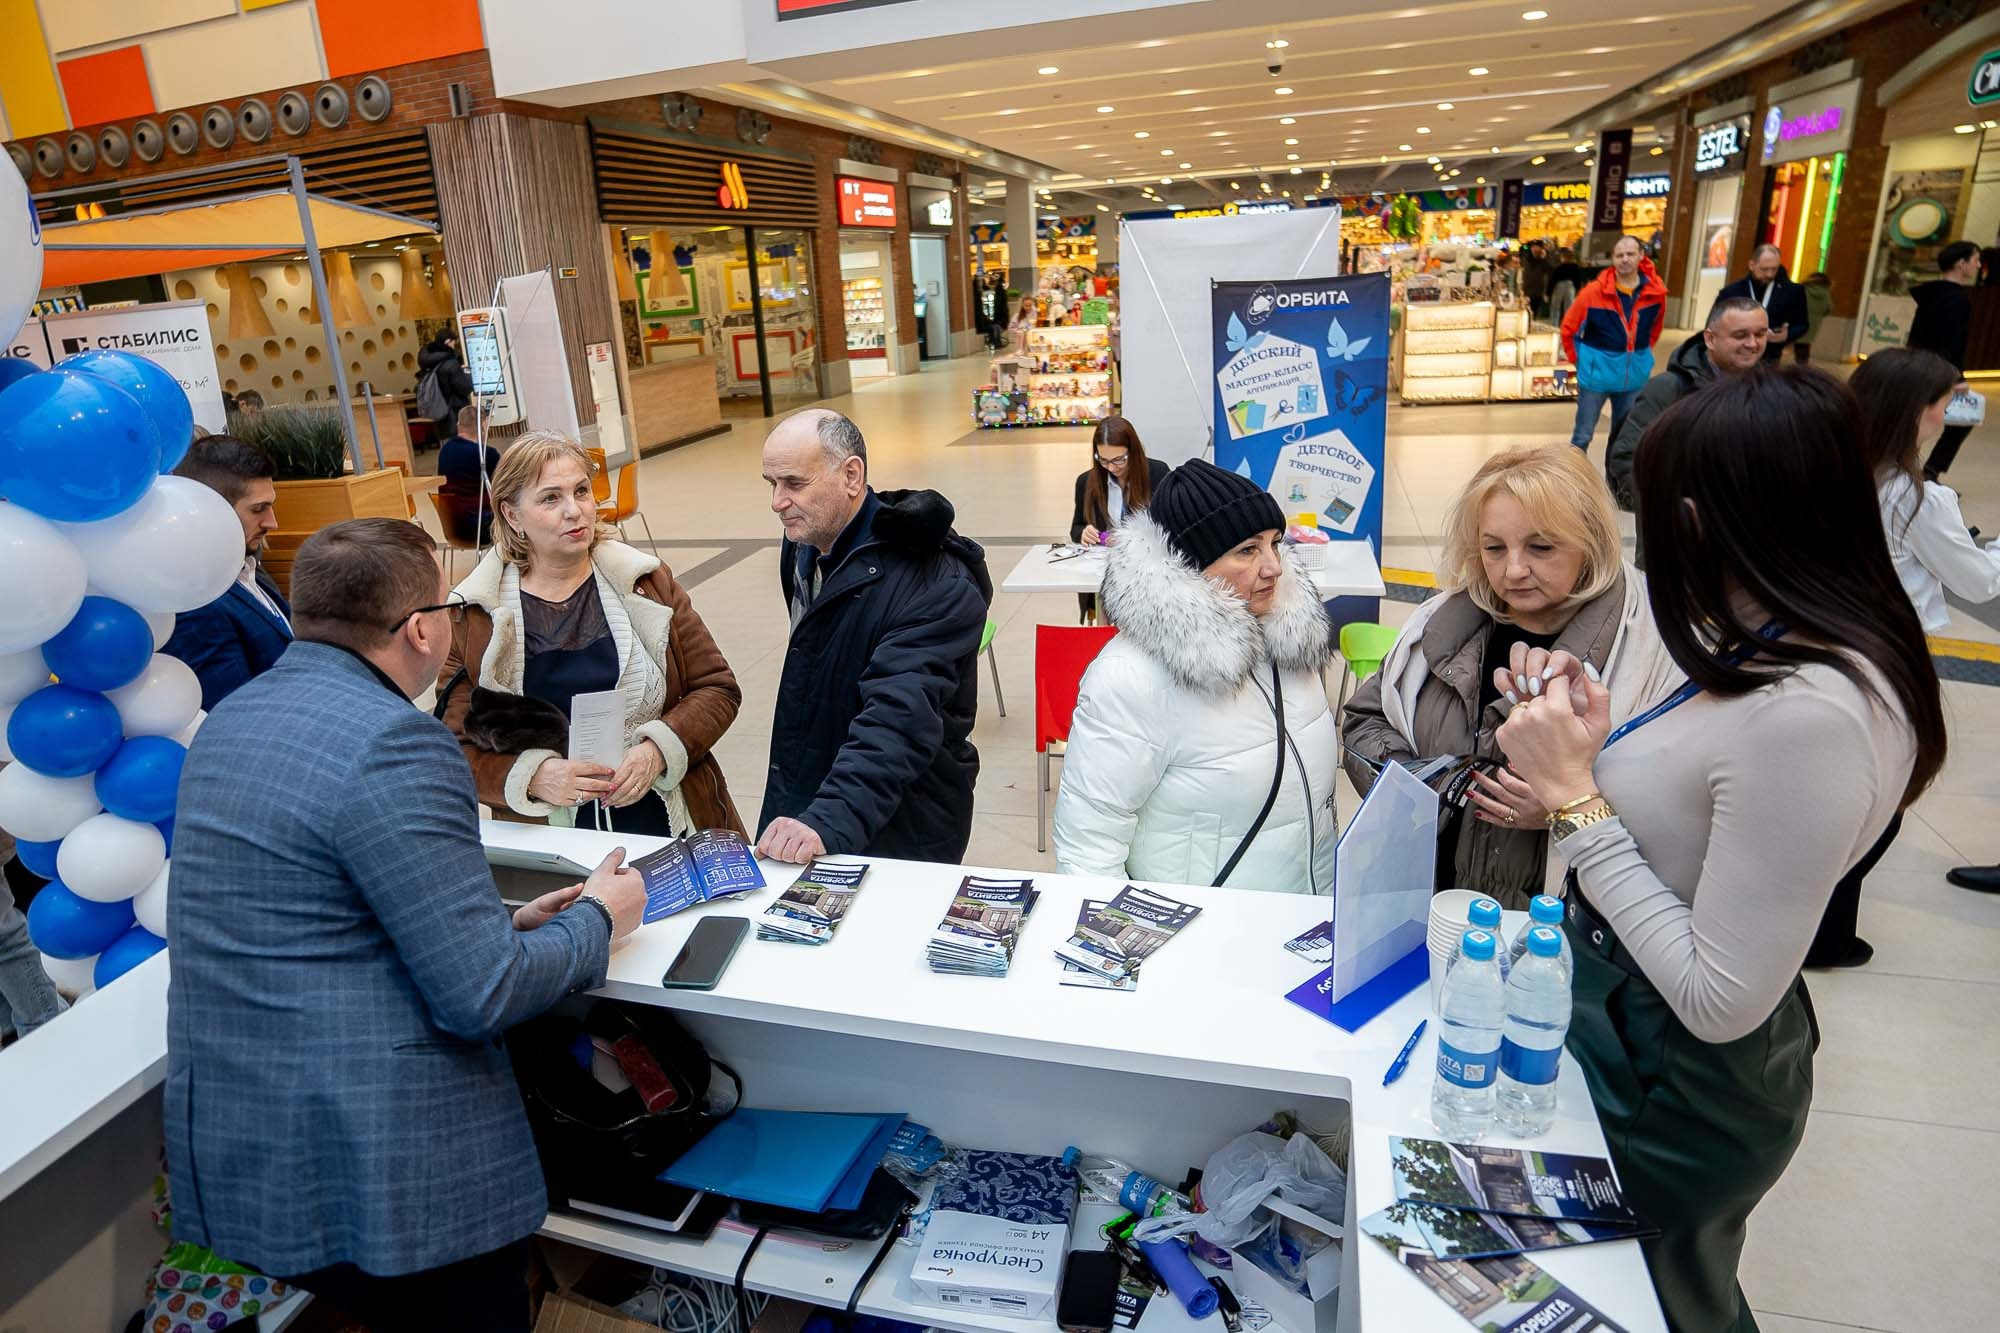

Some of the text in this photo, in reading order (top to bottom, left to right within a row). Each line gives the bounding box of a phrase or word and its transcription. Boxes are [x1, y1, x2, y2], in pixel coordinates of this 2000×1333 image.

[1697, 127, 1739, 160] ESTEL
[1276, 290, 1350, 309] ОРБИТА
[97, 328, 199, 350] СТАБИЛИС
[1229, 344, 1302, 377] ДЕТСКИЙ
[1225, 360, 1313, 391] МАСТЕР-КЛАСС
[1246, 376, 1300, 395] АППЛИКАЦИЯ
[1297, 444, 1365, 470] ДЕТСКОЕ
[1288, 459, 1362, 485] ТВОРЧЕСТВО
[932, 1249, 1044, 1273] Снегурочка
